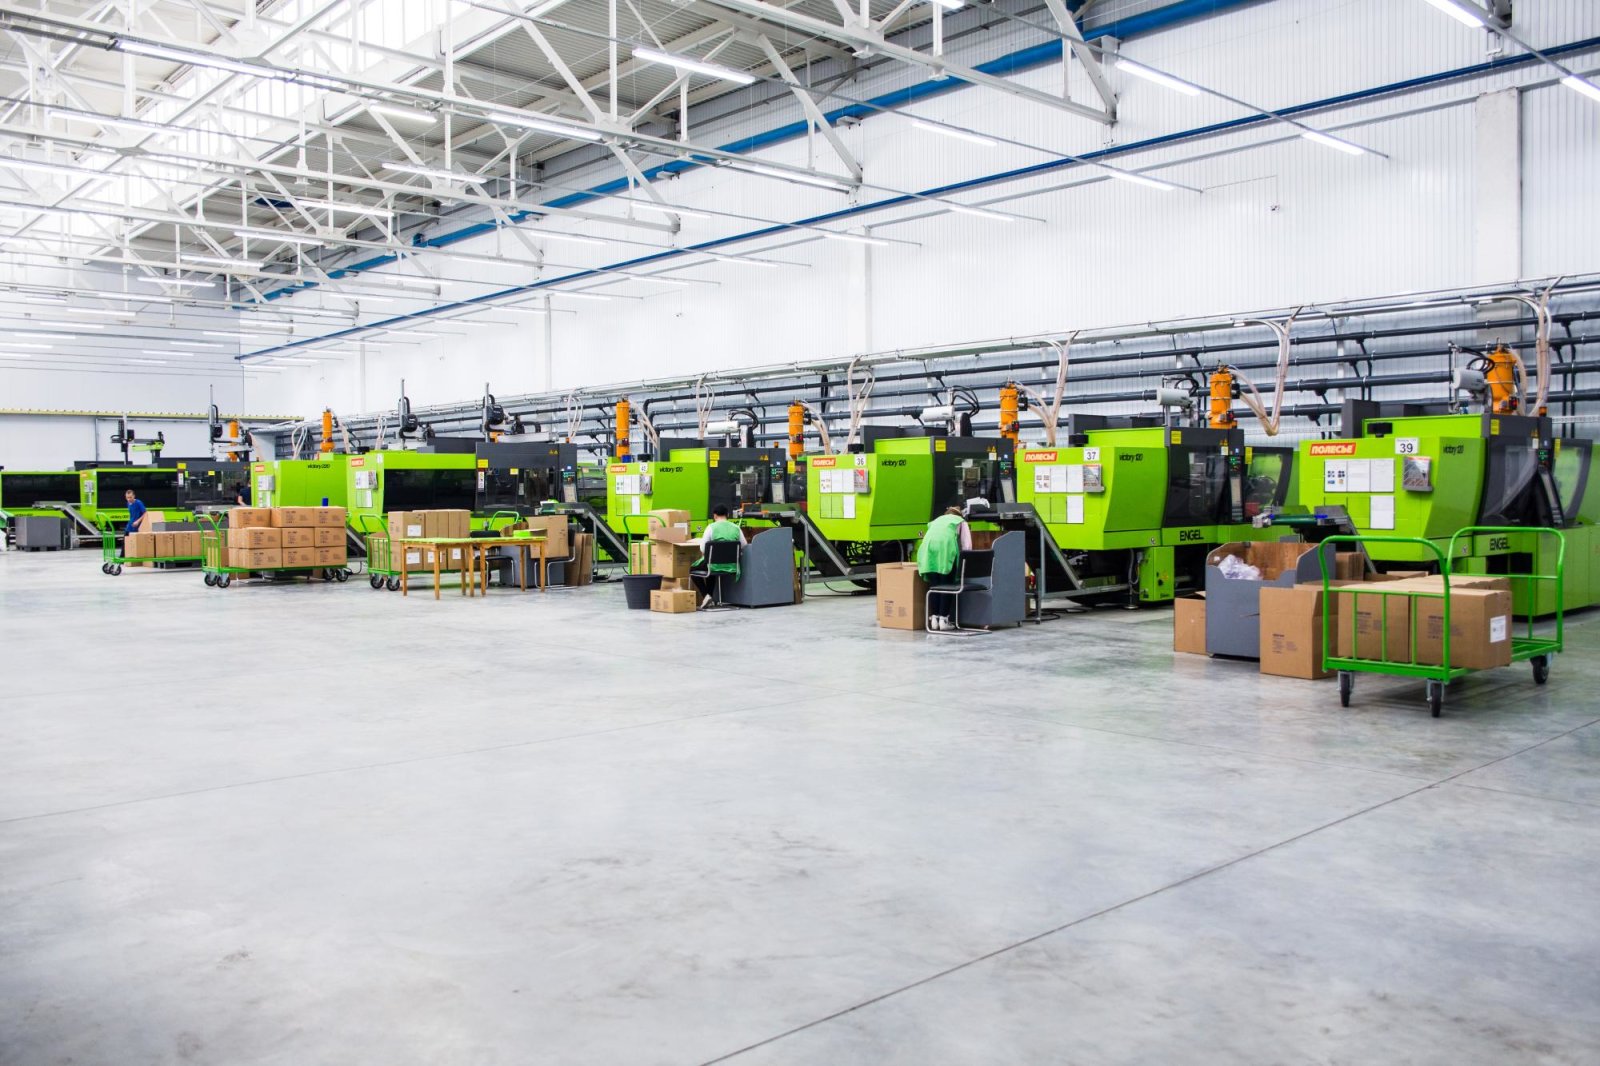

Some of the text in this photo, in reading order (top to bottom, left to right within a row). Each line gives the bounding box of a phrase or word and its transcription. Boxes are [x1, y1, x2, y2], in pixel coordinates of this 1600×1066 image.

[1311, 444, 1354, 454] ПОЛЕСЬЕ
[1400, 443, 1413, 453] 39
[1087, 451, 1096, 460] 37
[1180, 529, 1204, 541] ENGEL
[1490, 537, 1510, 551] ENGEL
